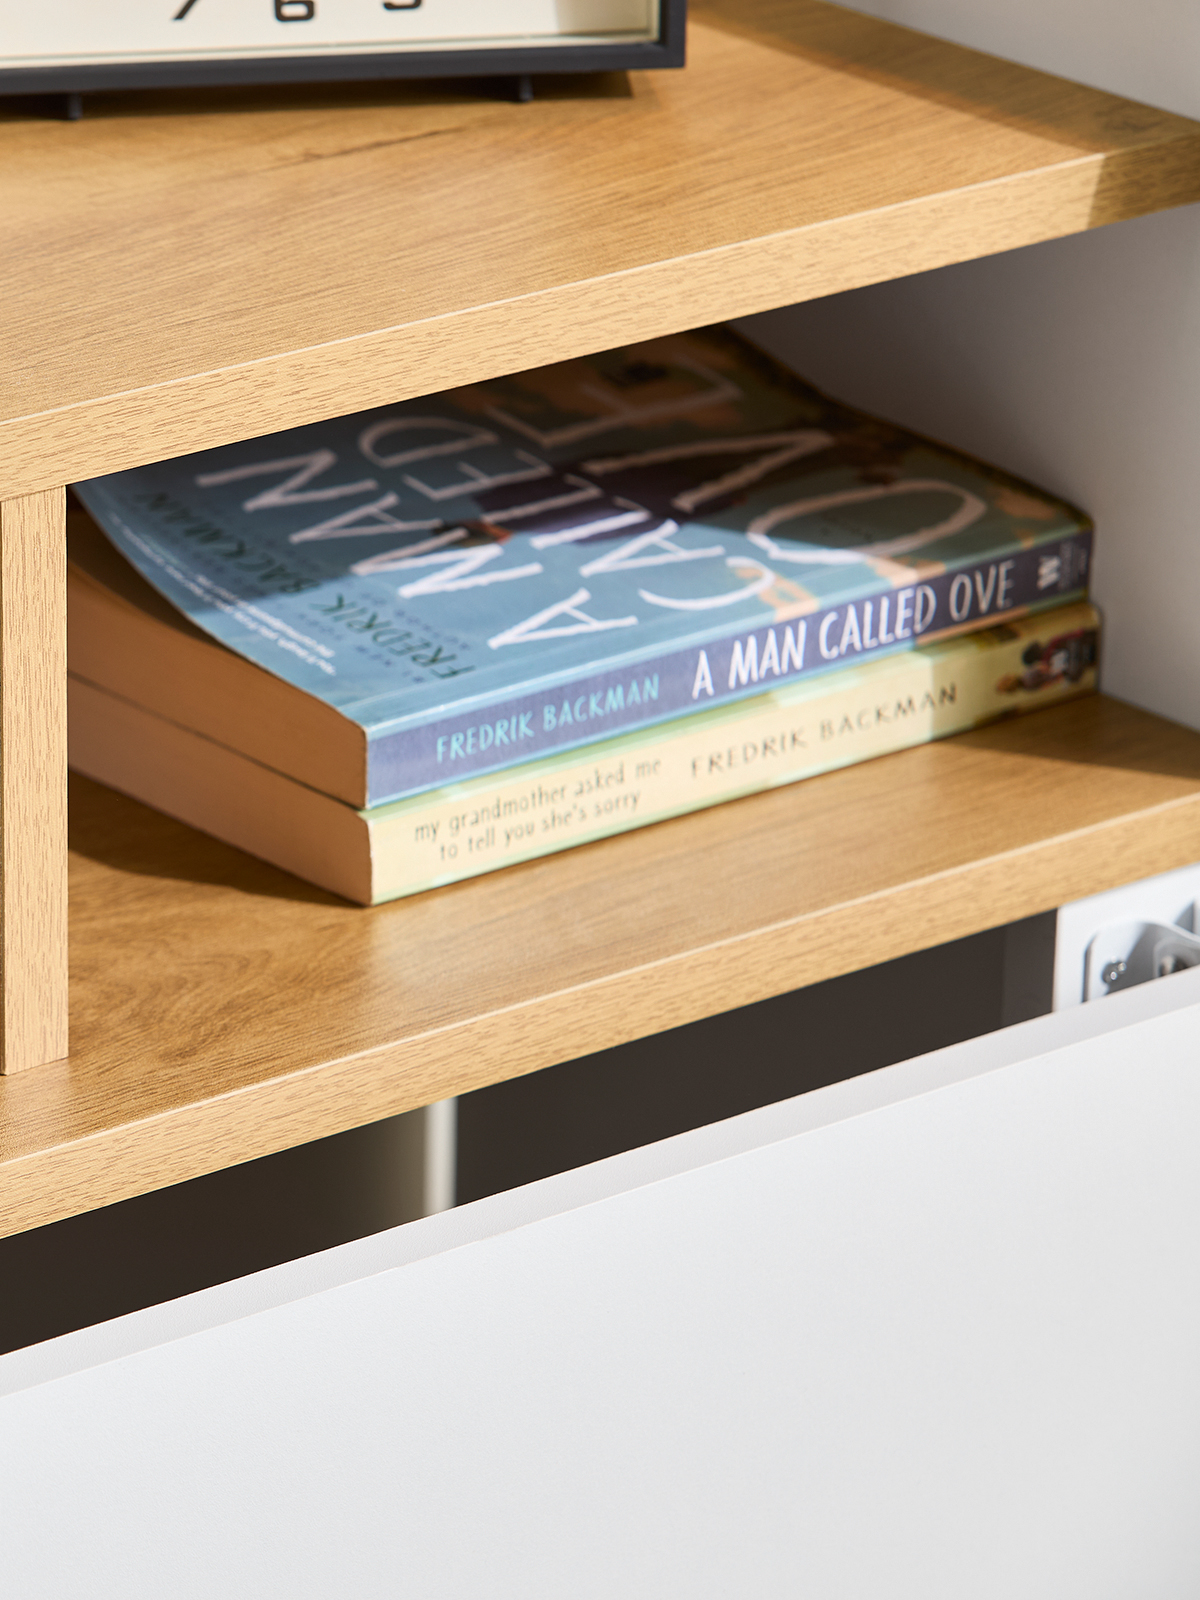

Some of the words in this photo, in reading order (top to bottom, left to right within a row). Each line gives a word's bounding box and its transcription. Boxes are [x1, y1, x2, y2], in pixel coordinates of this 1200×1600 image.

[488, 350, 989, 567] OVE
[195, 448, 546, 600] MAN
[357, 415, 777, 612] CALLED
[307, 592, 477, 680] FREDRIK
[488, 585, 640, 651] A
[691, 648, 716, 700] A
[727, 618, 808, 690] MAN
[818, 584, 939, 661] CALLED
[948, 559, 1016, 623] OVE
[436, 710, 536, 764] FREDRIK
[542, 672, 660, 733] BACKMAN
[690, 729, 810, 779] FREDRIK
[819, 683, 958, 744] BACKMAN
[414, 817, 441, 843] my
[449, 784, 568, 839] grandmother
[573, 760, 626, 798] asked
[635, 757, 662, 780] me
[439, 843, 459, 862] to
[467, 823, 497, 853] tell
[503, 821, 537, 849] you
[541, 801, 589, 833] she's
[594, 789, 642, 819] sorry
